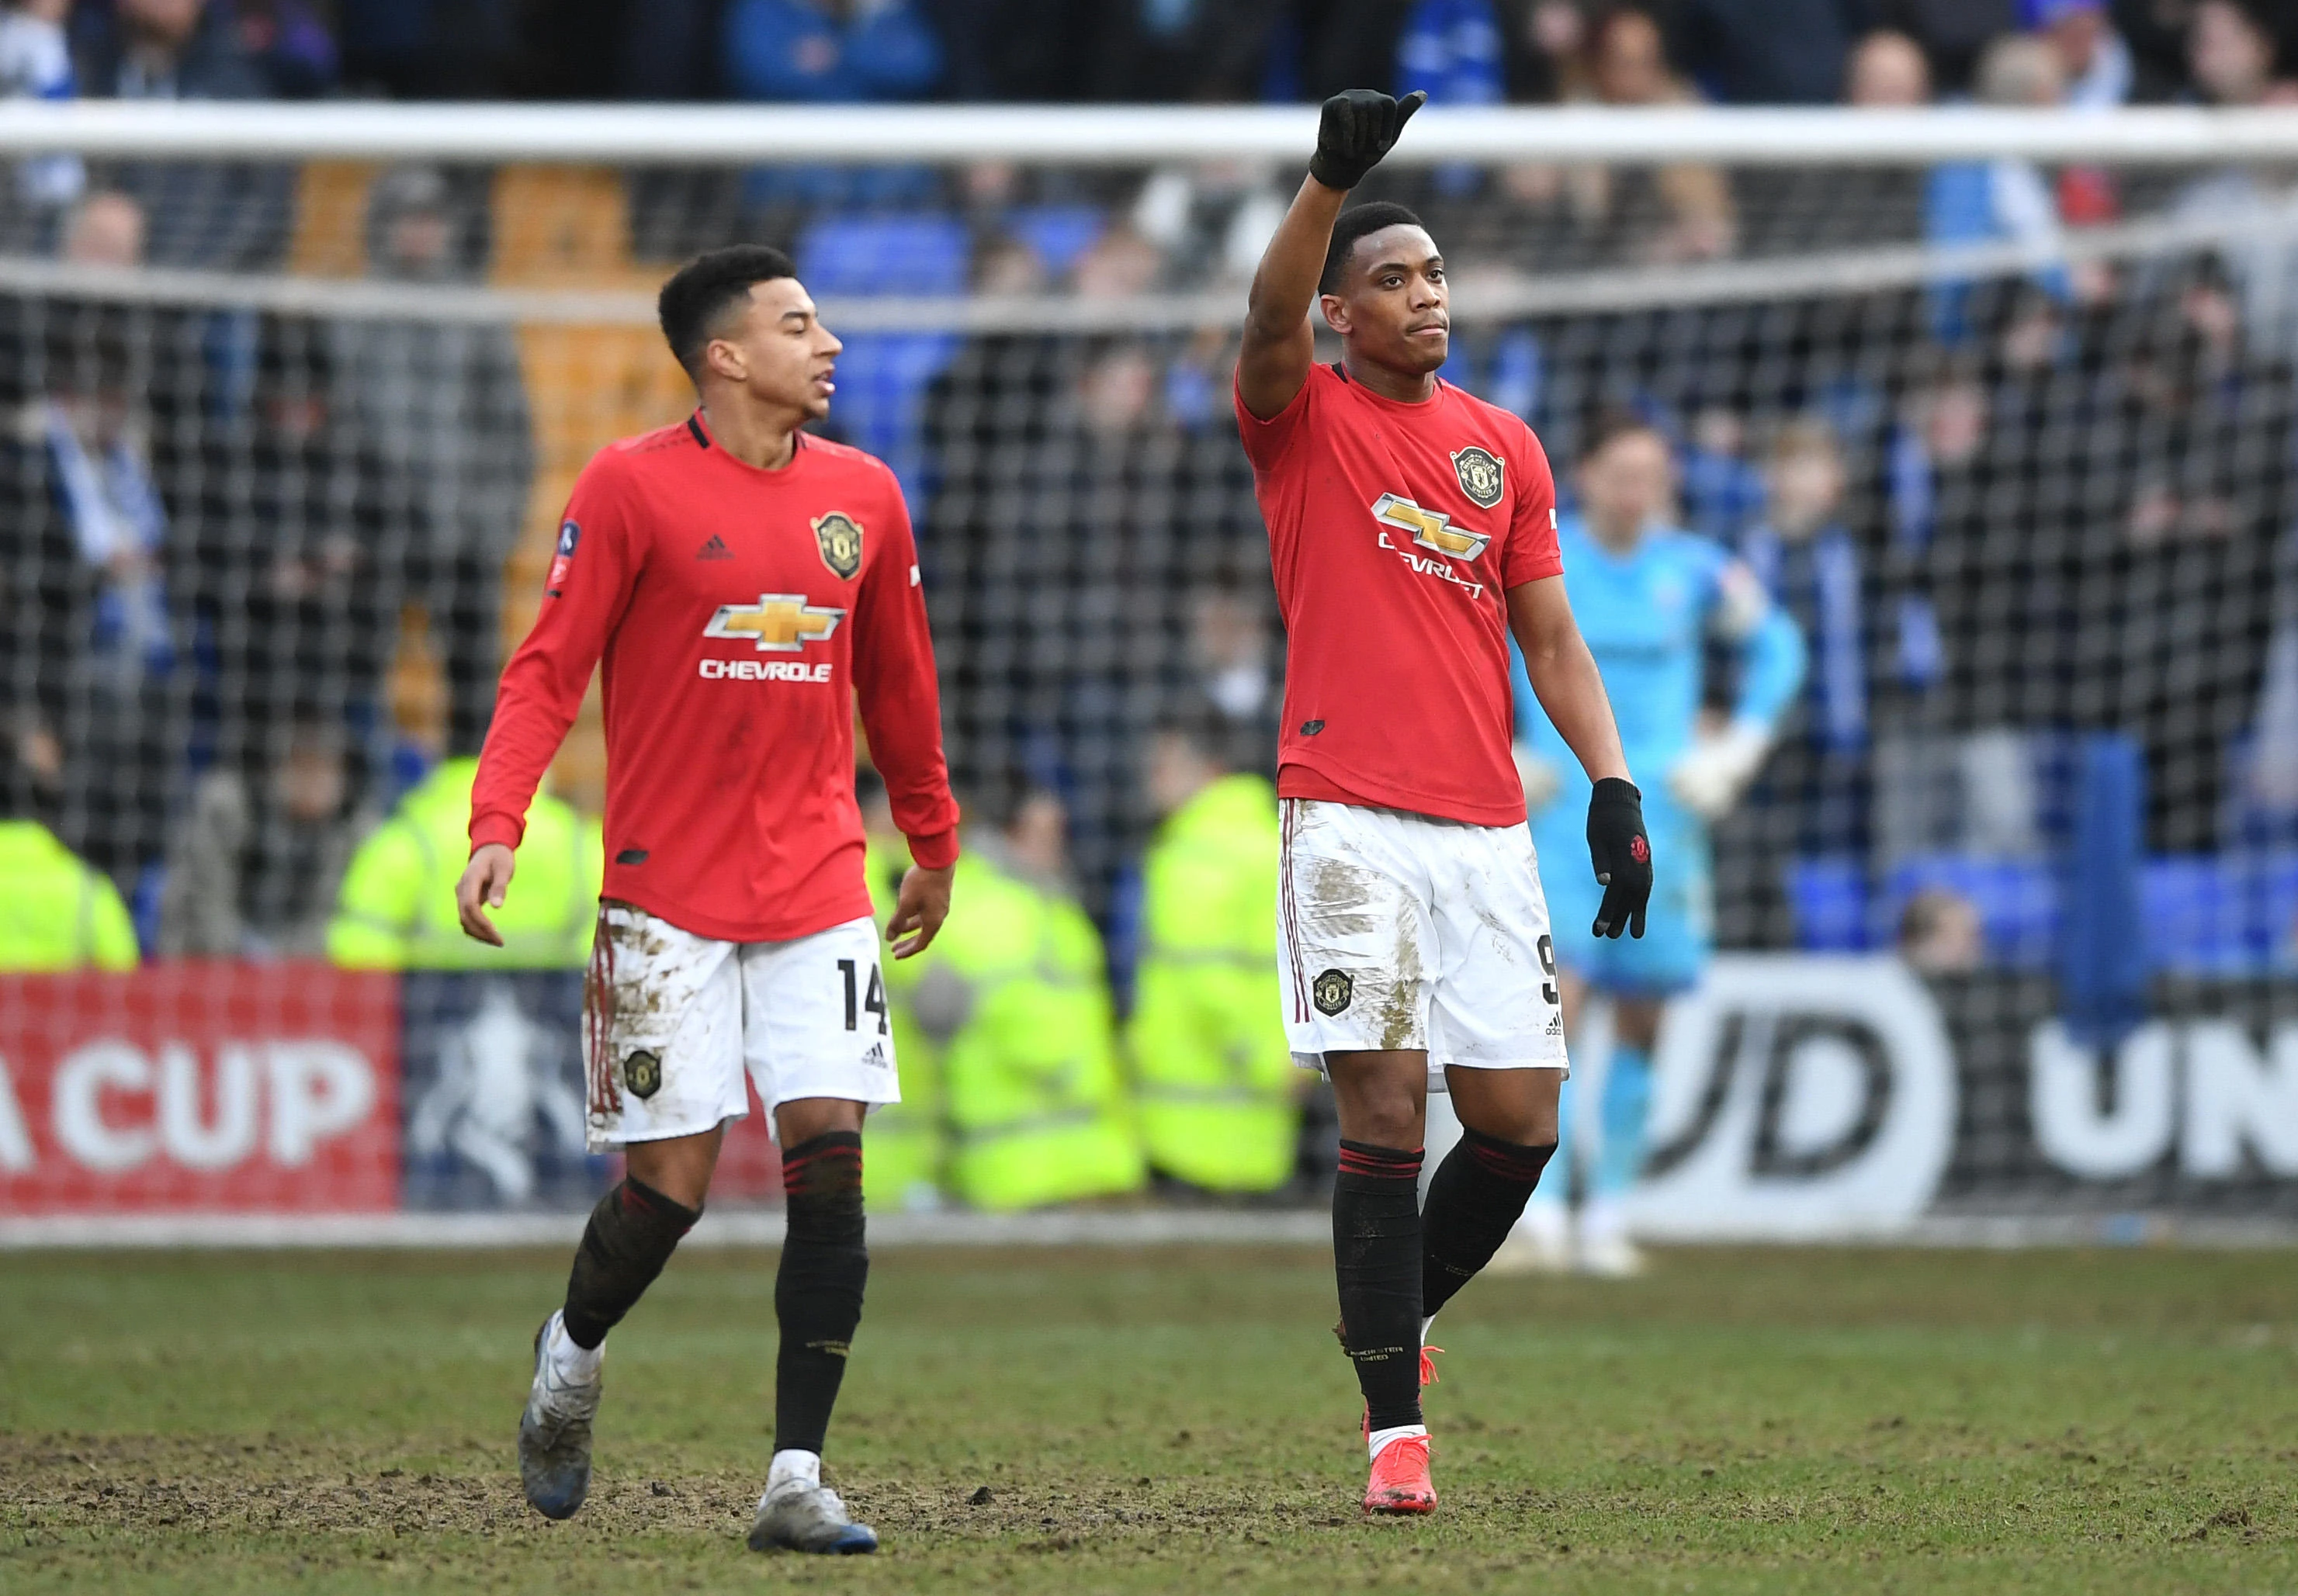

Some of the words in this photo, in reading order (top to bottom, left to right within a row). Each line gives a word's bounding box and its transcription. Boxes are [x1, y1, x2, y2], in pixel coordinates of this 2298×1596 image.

[837, 959, 887, 1036] 14
[1537, 934, 1559, 1005] 9
[53, 1037, 377, 1175] CUP
[1639, 1011, 1894, 1181] JD
